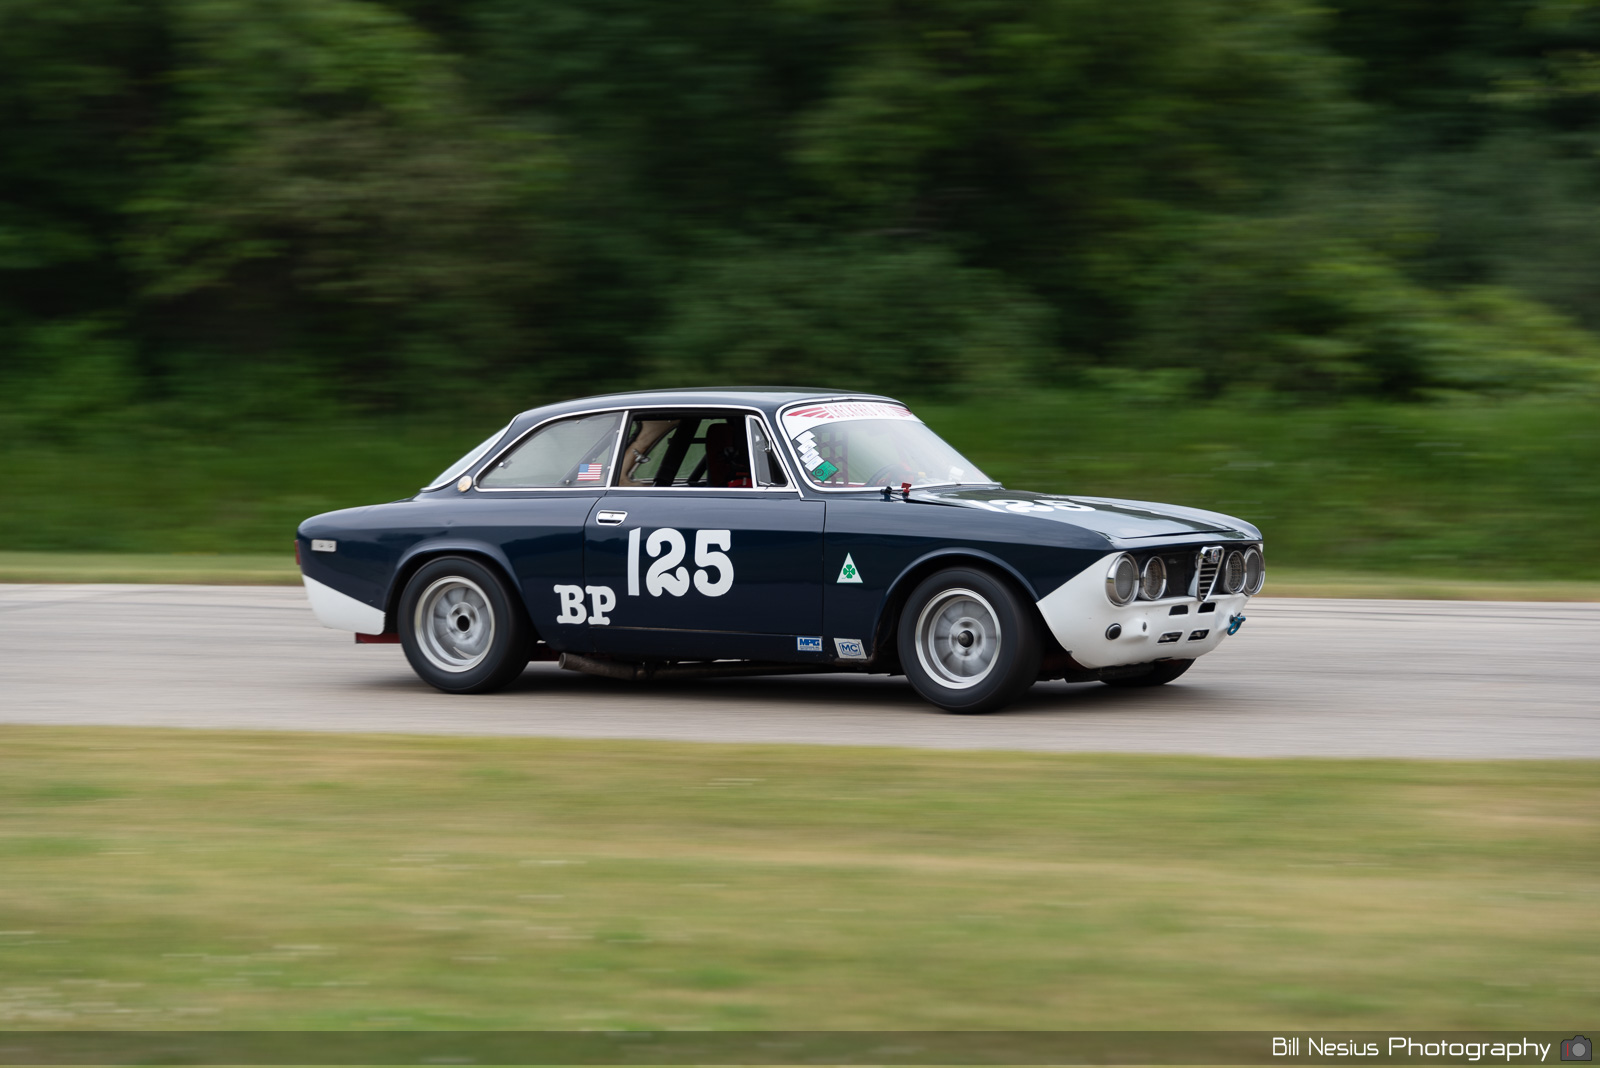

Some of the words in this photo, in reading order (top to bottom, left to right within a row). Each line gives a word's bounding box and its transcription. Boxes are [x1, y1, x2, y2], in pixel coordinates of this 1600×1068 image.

[963, 499, 1096, 514] 125
[628, 527, 734, 597] 125
[553, 584, 616, 626] BP
[841, 644, 858, 652] MC
